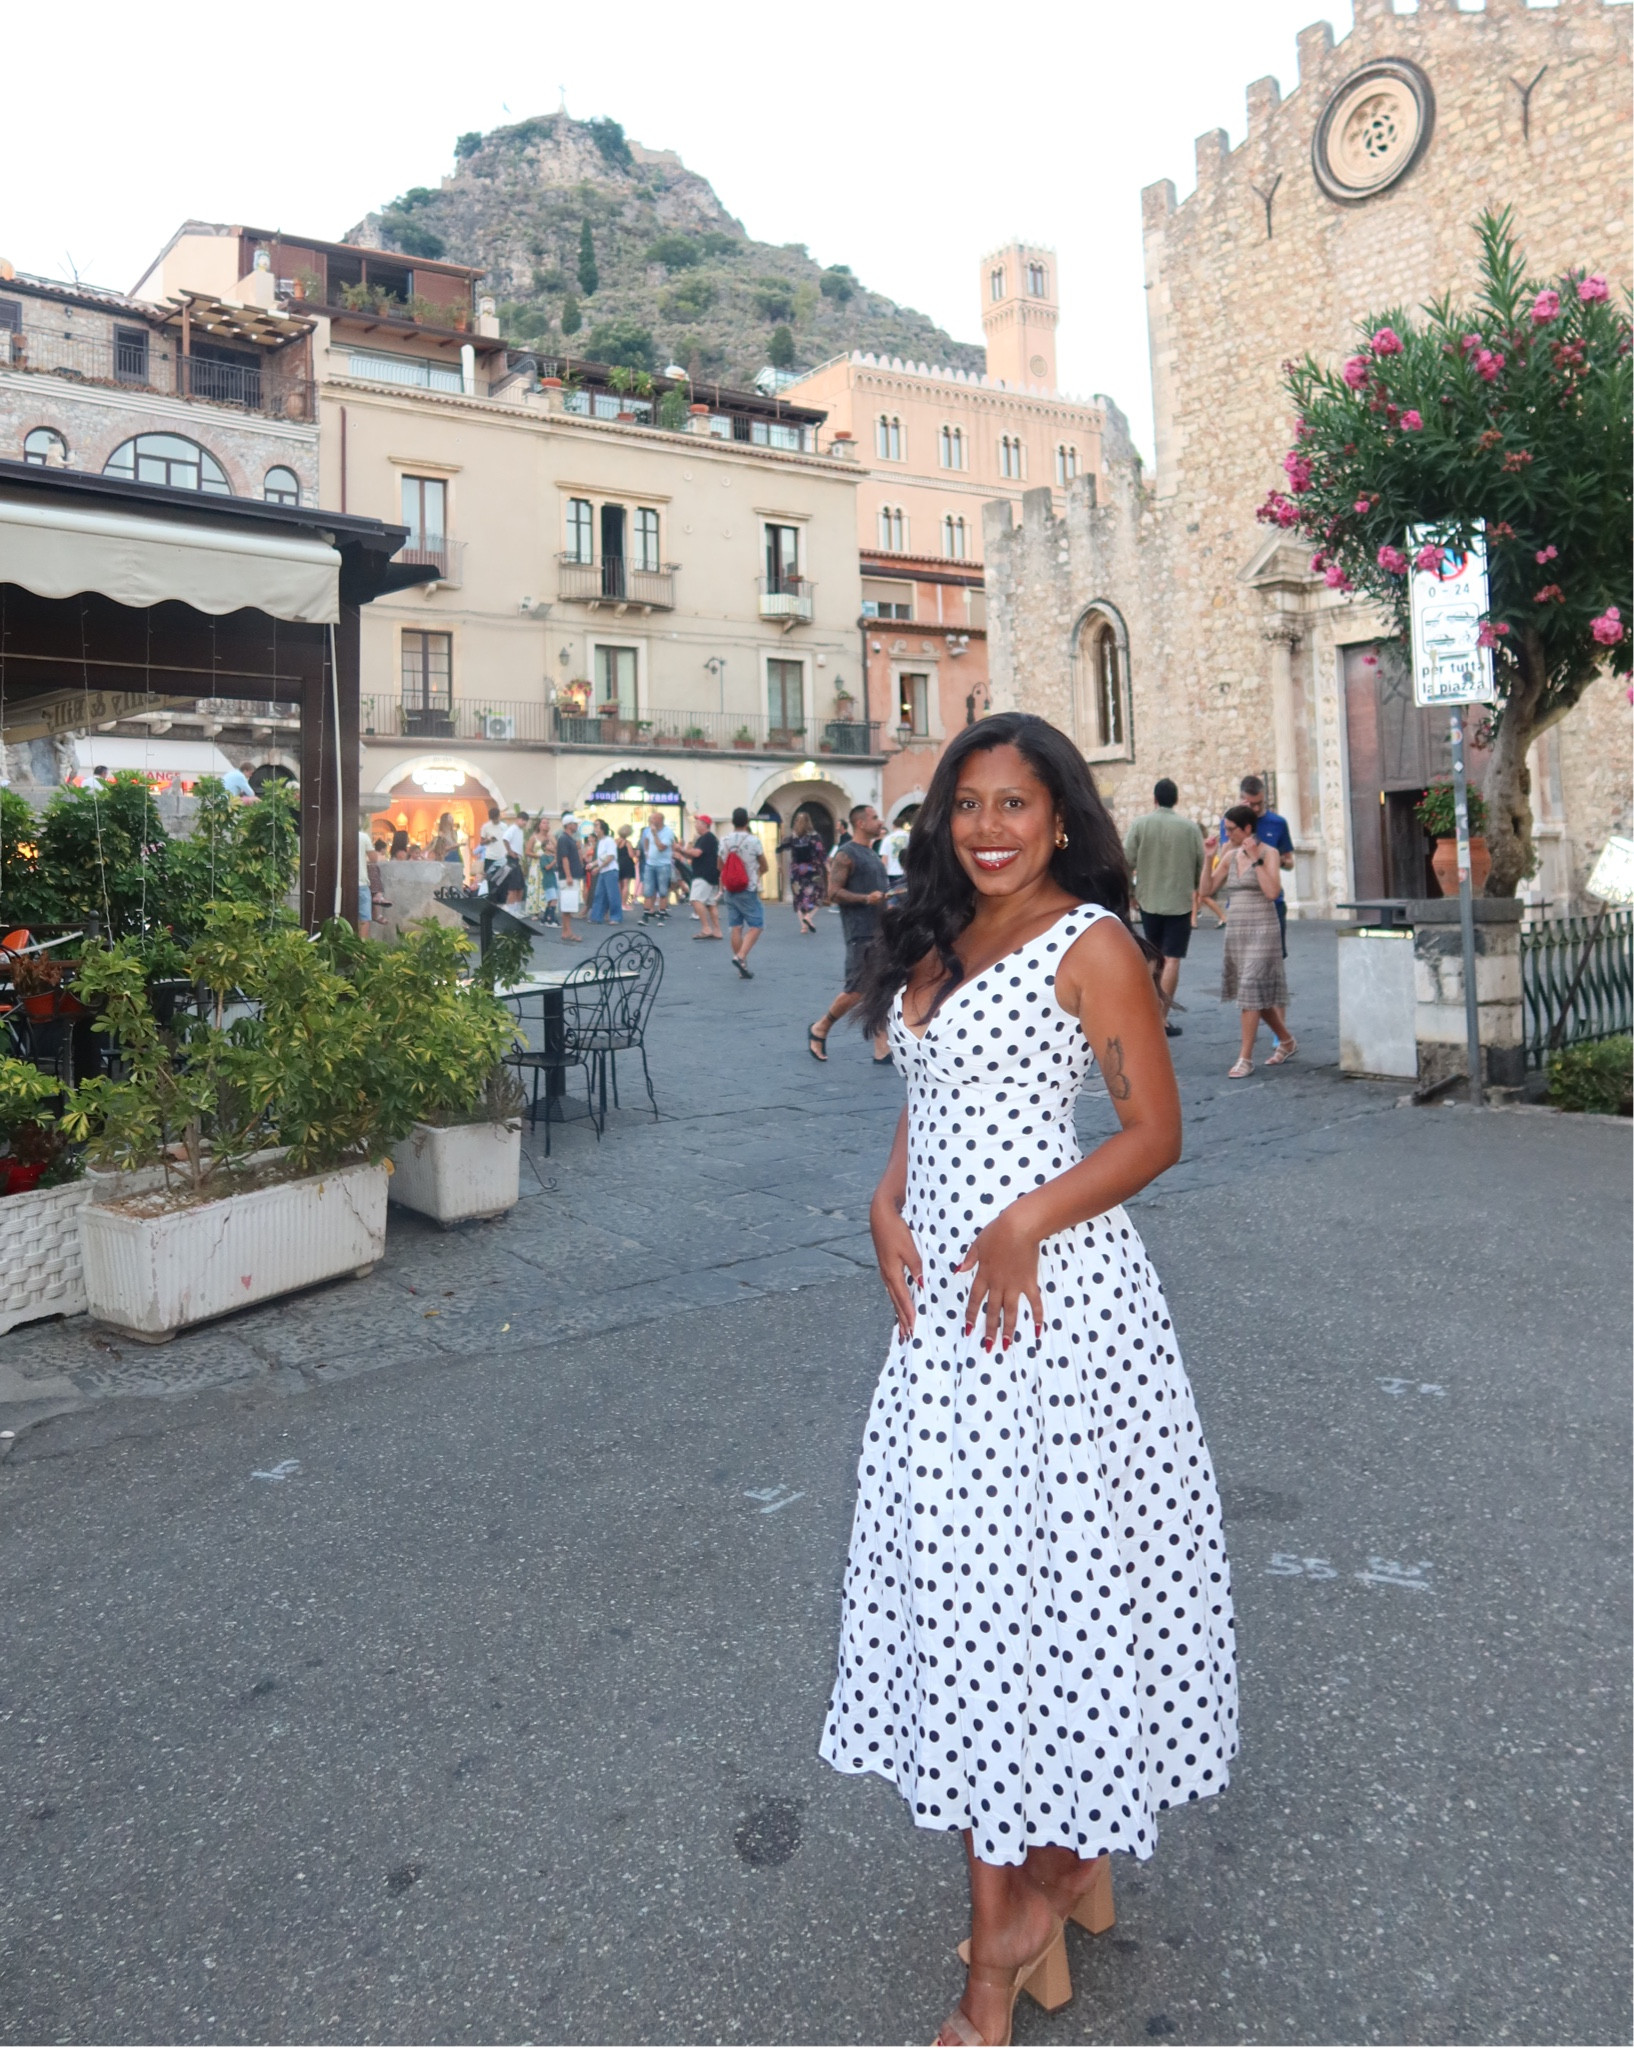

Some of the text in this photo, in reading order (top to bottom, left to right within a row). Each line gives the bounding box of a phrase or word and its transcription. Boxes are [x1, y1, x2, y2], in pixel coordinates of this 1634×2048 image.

[1428, 586, 1436, 598] 0
[1455, 583, 1470, 595] 24
[1422, 661, 1485, 678] per tutta
[1423, 680, 1485, 695] la piazza
[643, 791, 679, 802] brands
